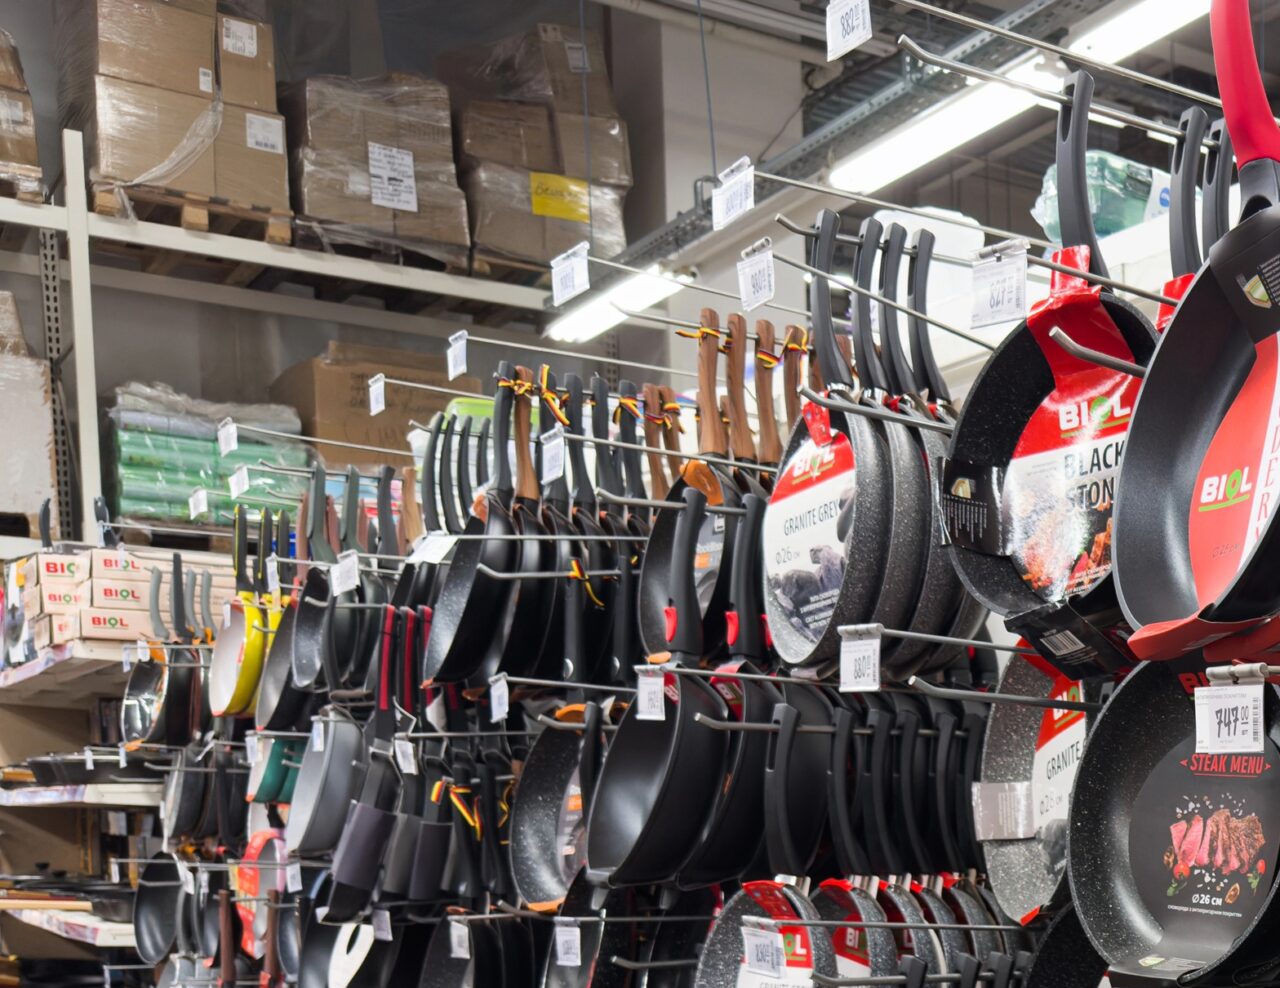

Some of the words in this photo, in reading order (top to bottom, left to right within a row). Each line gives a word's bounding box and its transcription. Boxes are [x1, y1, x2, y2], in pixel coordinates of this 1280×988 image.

[1200, 467, 1252, 503] BIOL
[783, 506, 818, 536] GRANITE
[818, 499, 840, 528] GREY
[103, 588, 141, 600] BIOL
[91, 616, 129, 628] BIOL
[1215, 705, 1239, 738] 747
[1241, 705, 1249, 722] 00
[1190, 754, 1228, 774] STEAK
[1230, 754, 1264, 774] MENU
